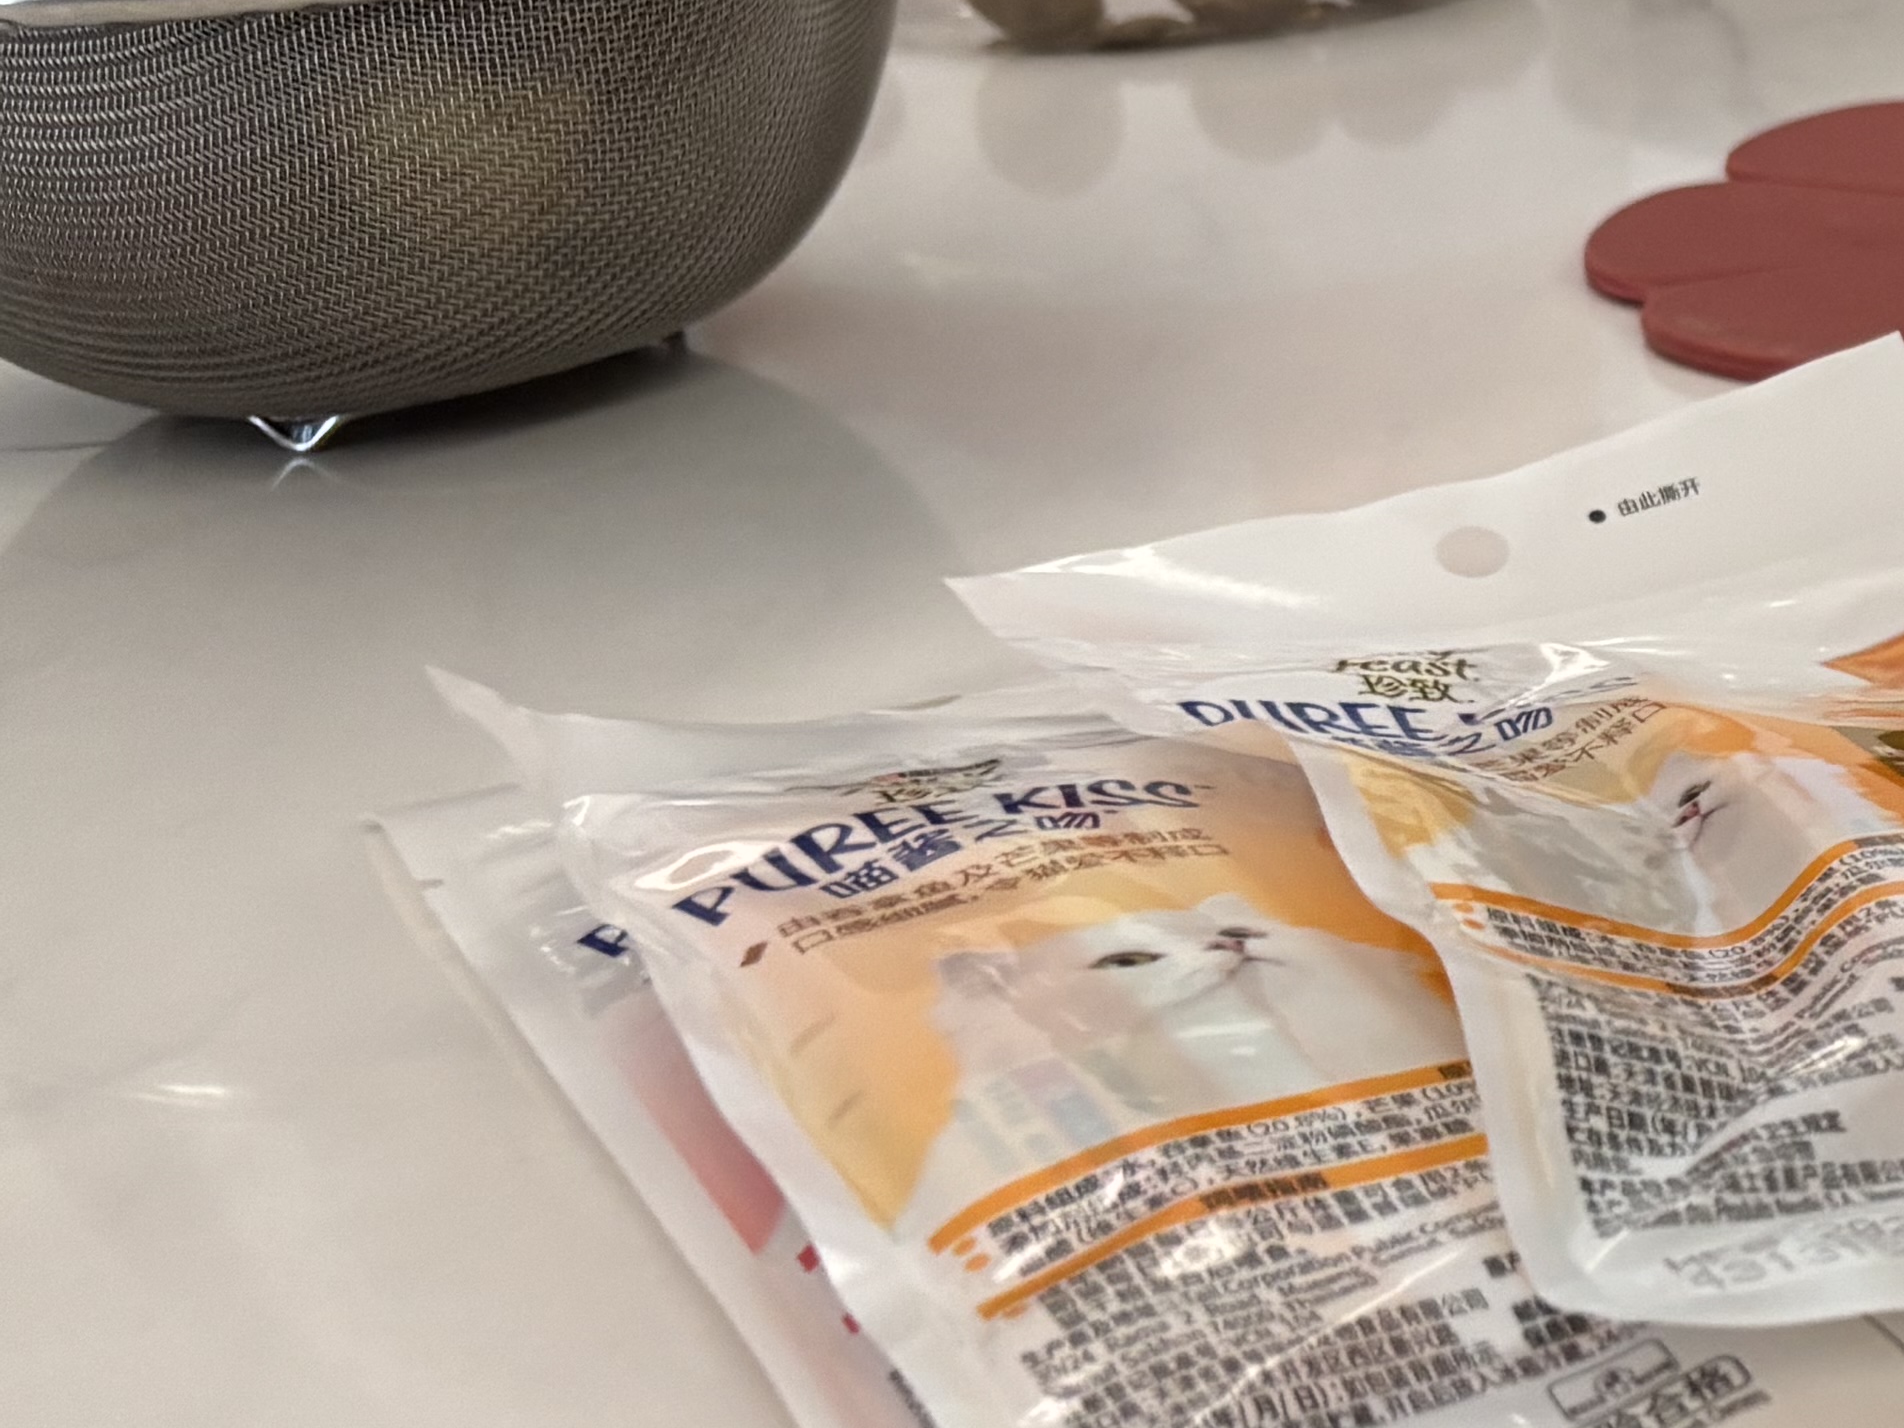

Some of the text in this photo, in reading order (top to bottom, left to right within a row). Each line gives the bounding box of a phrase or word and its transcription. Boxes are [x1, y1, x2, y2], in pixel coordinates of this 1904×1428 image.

[1617, 476, 1699, 517] 由此撕开
[672, 799, 980, 927] PUREE
[992, 778, 1201, 815] KISS
